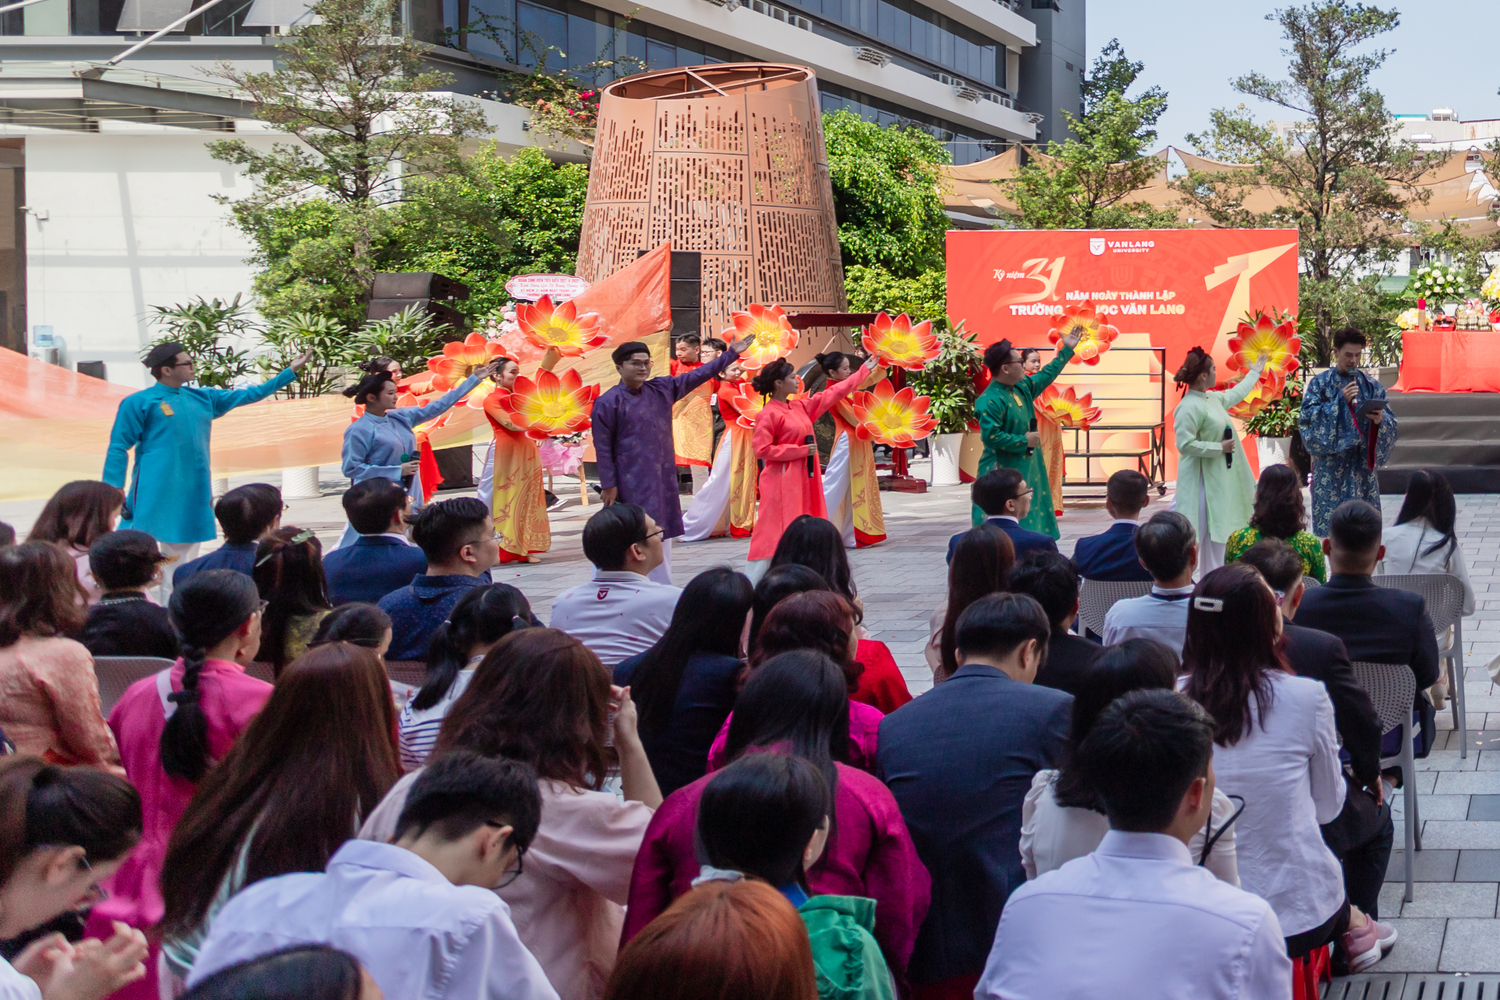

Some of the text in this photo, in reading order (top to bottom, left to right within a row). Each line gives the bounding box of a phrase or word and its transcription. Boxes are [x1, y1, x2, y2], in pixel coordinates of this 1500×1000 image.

[1004, 256, 1066, 306] 31
[1066, 290, 1176, 301] NĂM NGÀY THÀNH LẬP
[1009, 301, 1063, 316] TRƯỜNG
[1120, 302, 1147, 315] VĂN
[1150, 304, 1185, 315] LANG
